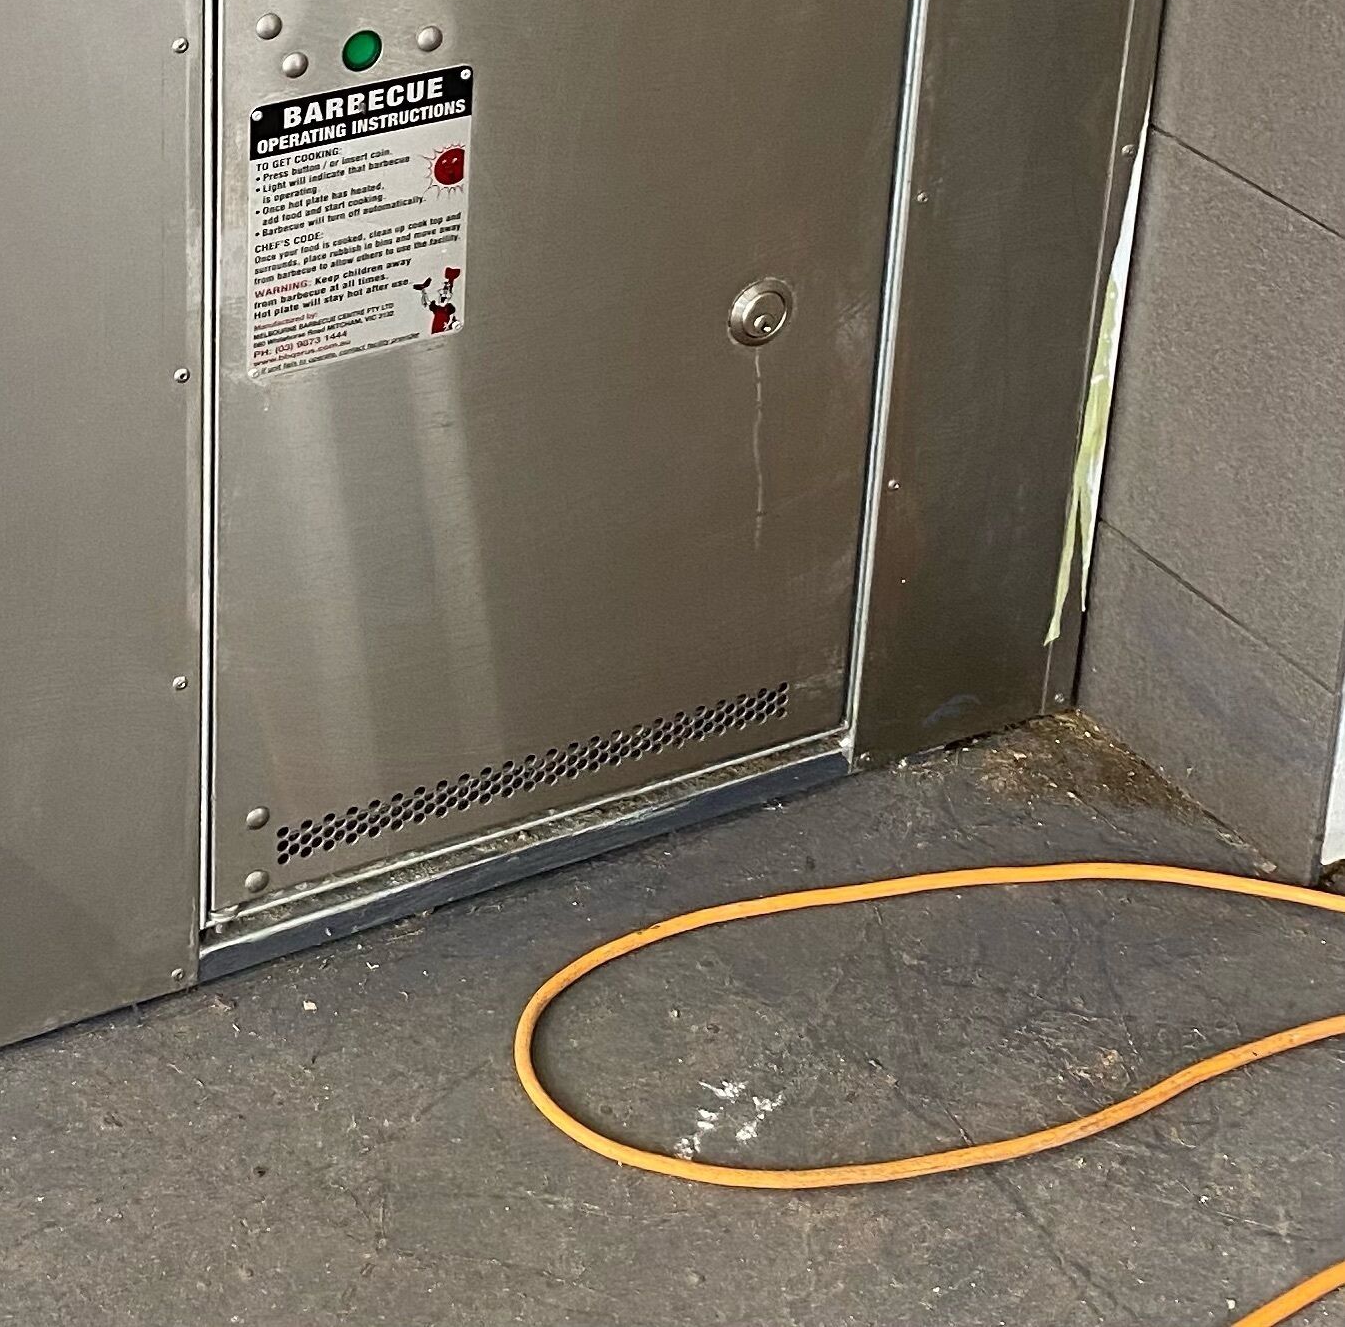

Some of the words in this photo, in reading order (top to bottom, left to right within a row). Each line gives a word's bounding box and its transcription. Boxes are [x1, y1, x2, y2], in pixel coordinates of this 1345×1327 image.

[283, 77, 443, 129] BARBECUE
[257, 123, 346, 155] OPERATING
[352, 99, 466, 135] INSTRUCTIONS
[256, 163, 268, 171] TO
[273, 158, 291, 168] GET
[295, 148, 342, 164] COOKING:
[263, 170, 288, 182] Press
[292, 164, 320, 175] button
[330, 159, 339, 167] or
[342, 152, 367, 164] insert
[371, 149, 392, 159] coin.
[263, 182, 286, 194] Light
[289, 177, 305, 186] will
[309, 169, 344, 182] indicate
[348, 164, 365, 174] that
[369, 156, 409, 170] barbecue
[263, 205, 285, 215] Once
[289, 200, 302, 209] hot
[306, 195, 328, 207] plate
[332, 190, 347, 199] has
[263, 217, 278, 225] add
[282, 211, 301, 221] food
[305, 207, 321, 216] and
[325, 201, 344, 212] start
[255, 255, 276, 263] Once
[279, 249, 298, 259] your
[301, 243, 319, 253] food
[369, 229, 392, 238] clean
[408, 220, 427, 229] cook
[430, 217, 443, 225] top
[446, 212, 461, 221] and
[263, 222, 304, 236] Barbecue
[308, 217, 324, 226] will
[328, 212, 345, 221] turn
[349, 209, 360, 218] off
[255, 238, 290, 253] CHEF'S
[294, 232, 323, 244] CODE:
[304, 253, 326, 265] place
[330, 245, 361, 257] rubbish
[375, 239, 392, 247] bins
[396, 233, 410, 242] and
[414, 229, 436, 238] move
[440, 224, 460, 233] away
[255, 275, 274, 284] from
[277, 266, 316, 279] barbecue
[331, 257, 354, 267] allow
[357, 251, 382, 262] others
[397, 245, 411, 253] use
[414, 241, 427, 249] the
[255, 280, 311, 298] WARNING:
[315, 275, 339, 284] Keep
[343, 265, 382, 278] children
[386, 258, 411, 268] away
[254, 299, 277, 309] from
[281, 287, 326, 303] barbecue
[330, 284, 338, 292] at
[343, 280, 354, 288] all
[358, 274, 388, 285] times.
[254, 310, 270, 319] Hot
[274, 304, 299, 316] plate
[303, 298, 320, 307] will
[324, 294, 344, 303] stay
[347, 288, 362, 298] hot
[366, 283, 388, 293] after
[254, 325, 296, 340] MELBOURNE
[299, 316, 335, 329] BARBECUE
[338, 309, 364, 320] CENTRE
[276, 343, 293, 353] (03)
[325, 331, 347, 341] 1444
